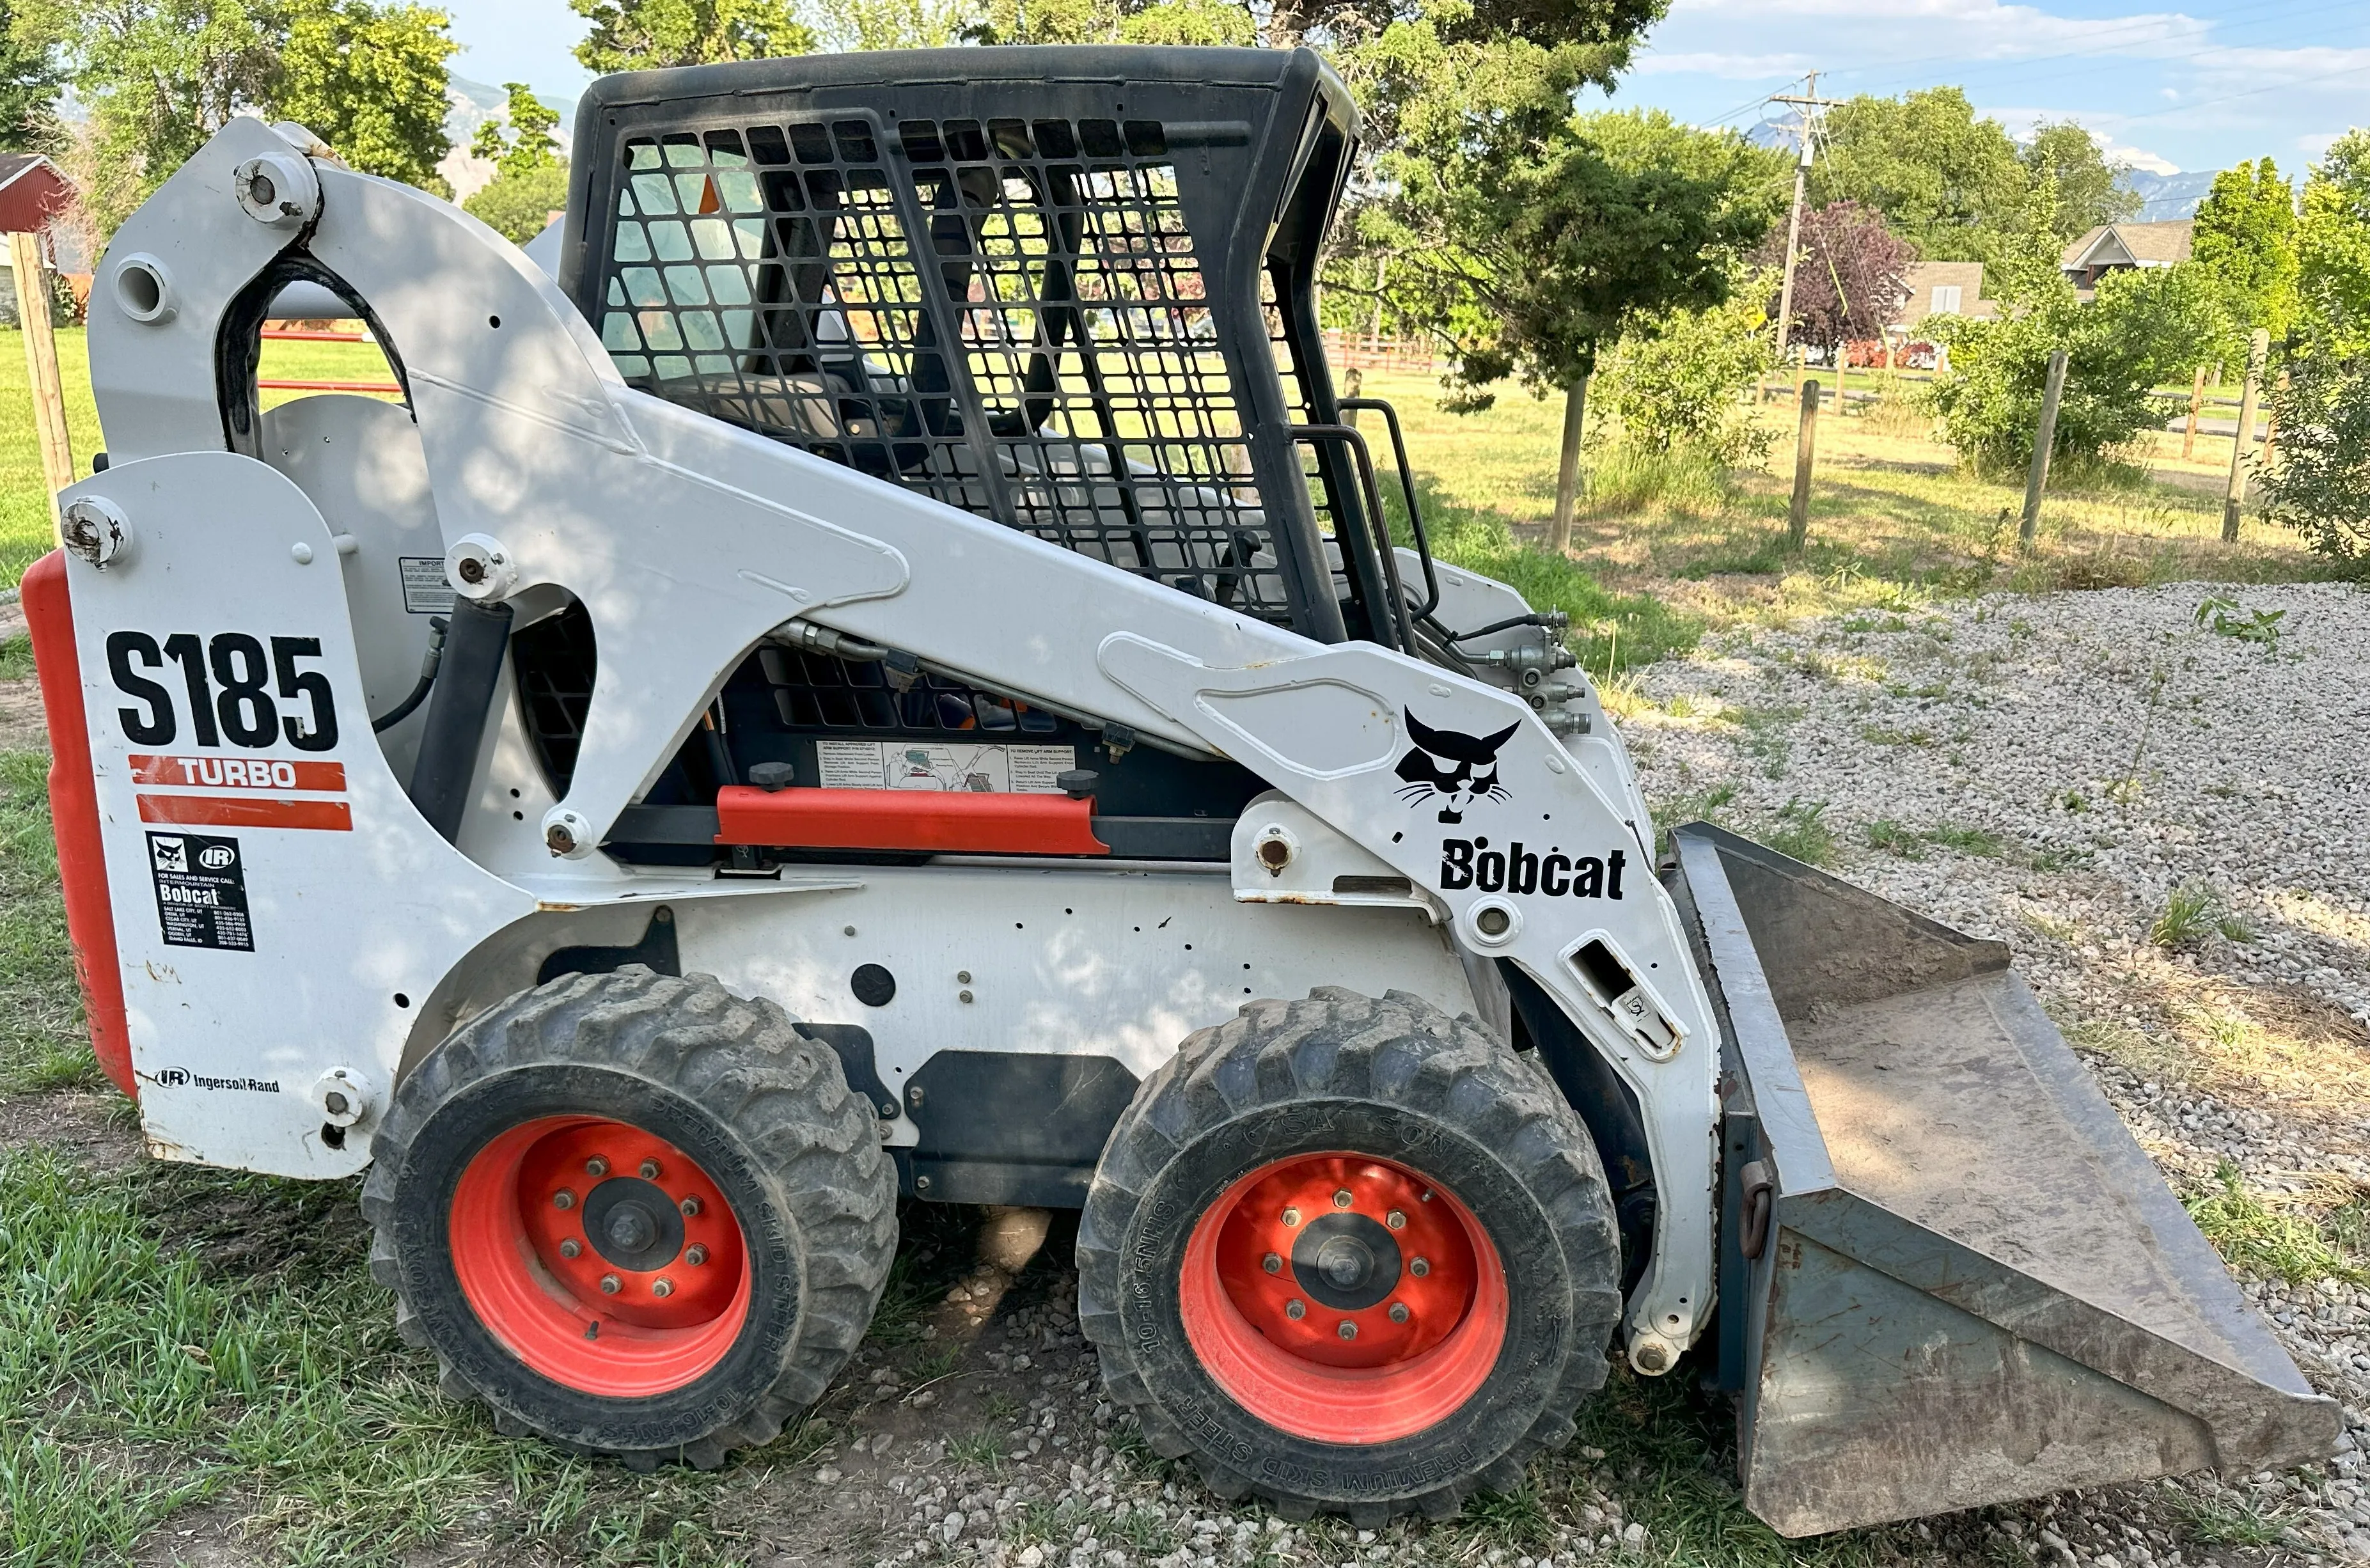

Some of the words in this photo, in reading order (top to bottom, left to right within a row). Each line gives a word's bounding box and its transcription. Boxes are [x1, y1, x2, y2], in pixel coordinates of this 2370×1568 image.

[106, 631, 338, 751] S185
[177, 758, 297, 788] TURBO
[1440, 838, 1626, 900] Bobcat
[160, 884, 219, 906] Bobcat
[1280, 1109, 1456, 1159] SAMSON
[647, 1095, 762, 1195] PREMIUM
[755, 1202, 789, 1264] SKID
[1175, 1395, 1253, 1462] STEER
[1261, 1457, 1329, 1487] SKID
[1342, 1443, 1476, 1492] PREMIUM
